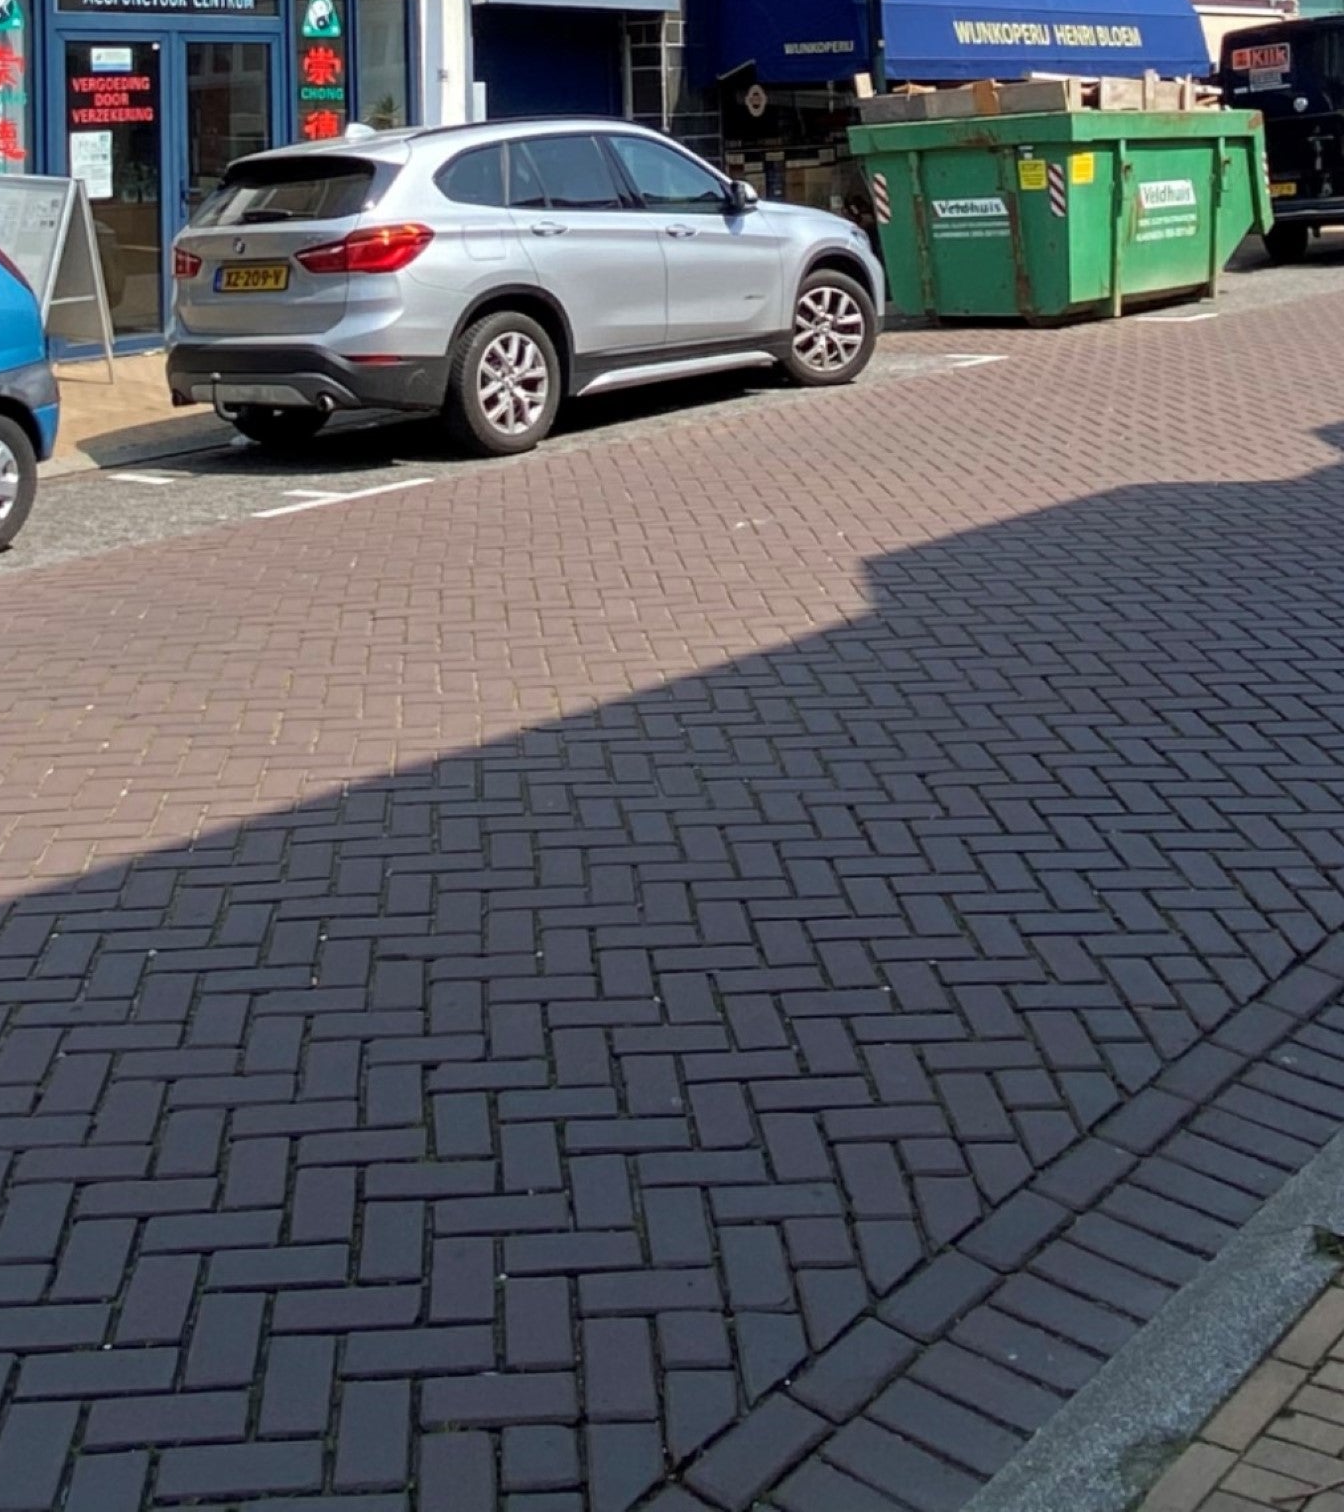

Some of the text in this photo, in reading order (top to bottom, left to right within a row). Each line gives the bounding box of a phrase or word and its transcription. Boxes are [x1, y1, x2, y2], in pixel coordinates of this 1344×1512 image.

[1053, 24, 1096, 46] HENRI
[1096, 25, 1142, 47] BLOEM
[72, 76, 151, 92] VERGOEDING
[94, 93, 130, 106] DOOR
[72, 107, 154, 123] VERZEKERING
